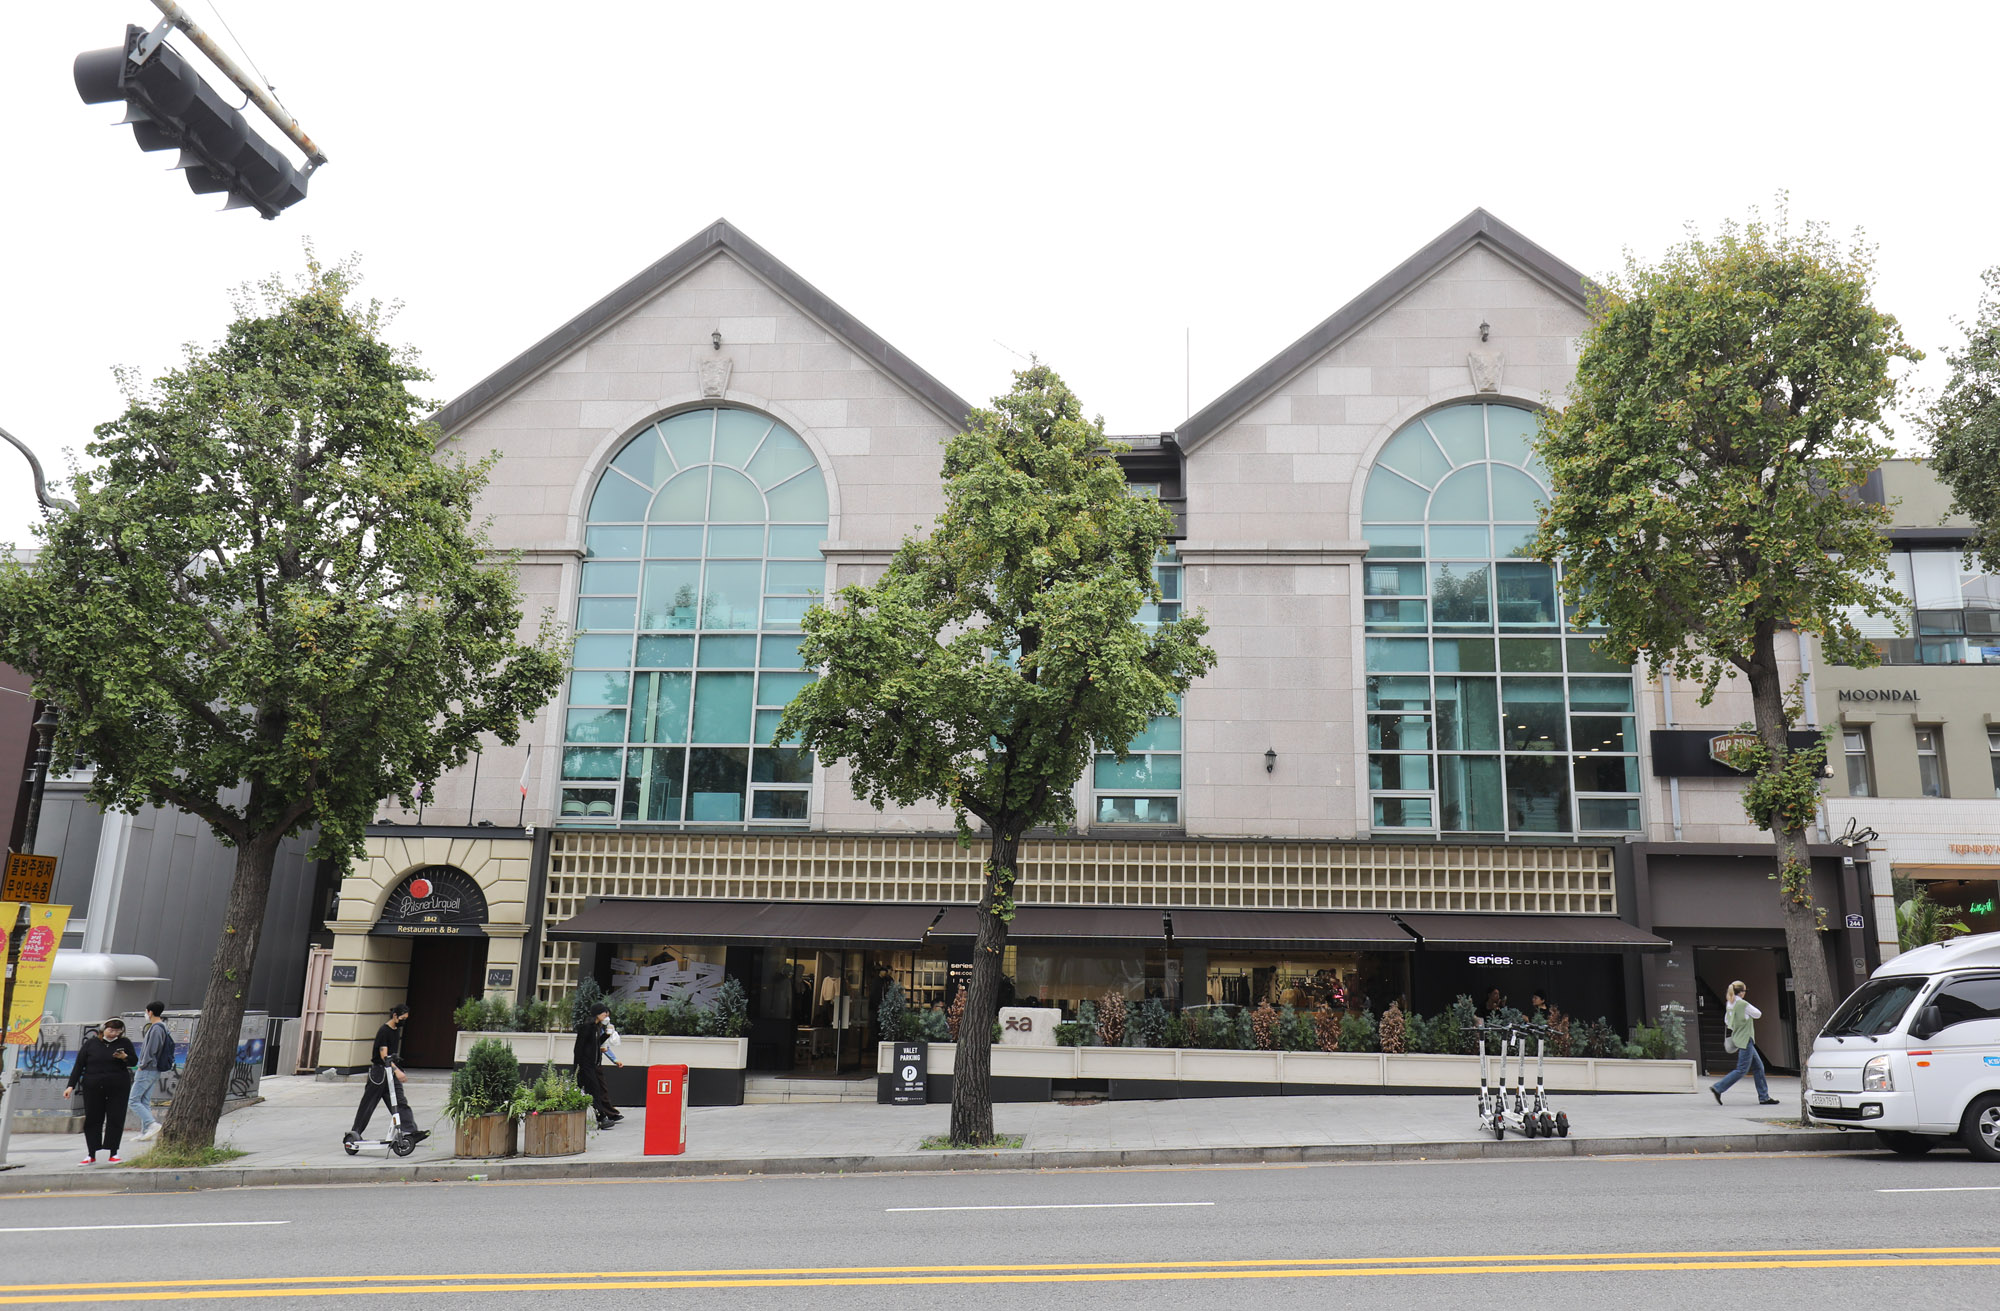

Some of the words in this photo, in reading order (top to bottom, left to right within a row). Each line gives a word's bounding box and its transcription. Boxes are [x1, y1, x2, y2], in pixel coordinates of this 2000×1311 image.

[1838, 689, 1921, 701] MOONDAL
[1716, 739, 1731, 752] TAP
[1949, 844, 1982, 856] TREND
[11, 858, 53, 878] 불법주정차
[7, 879, 48, 900] 무인단속중
[397, 925, 437, 933] Restaurant
[333, 969, 355, 979] 1842
[489, 972, 511, 982] 1842
